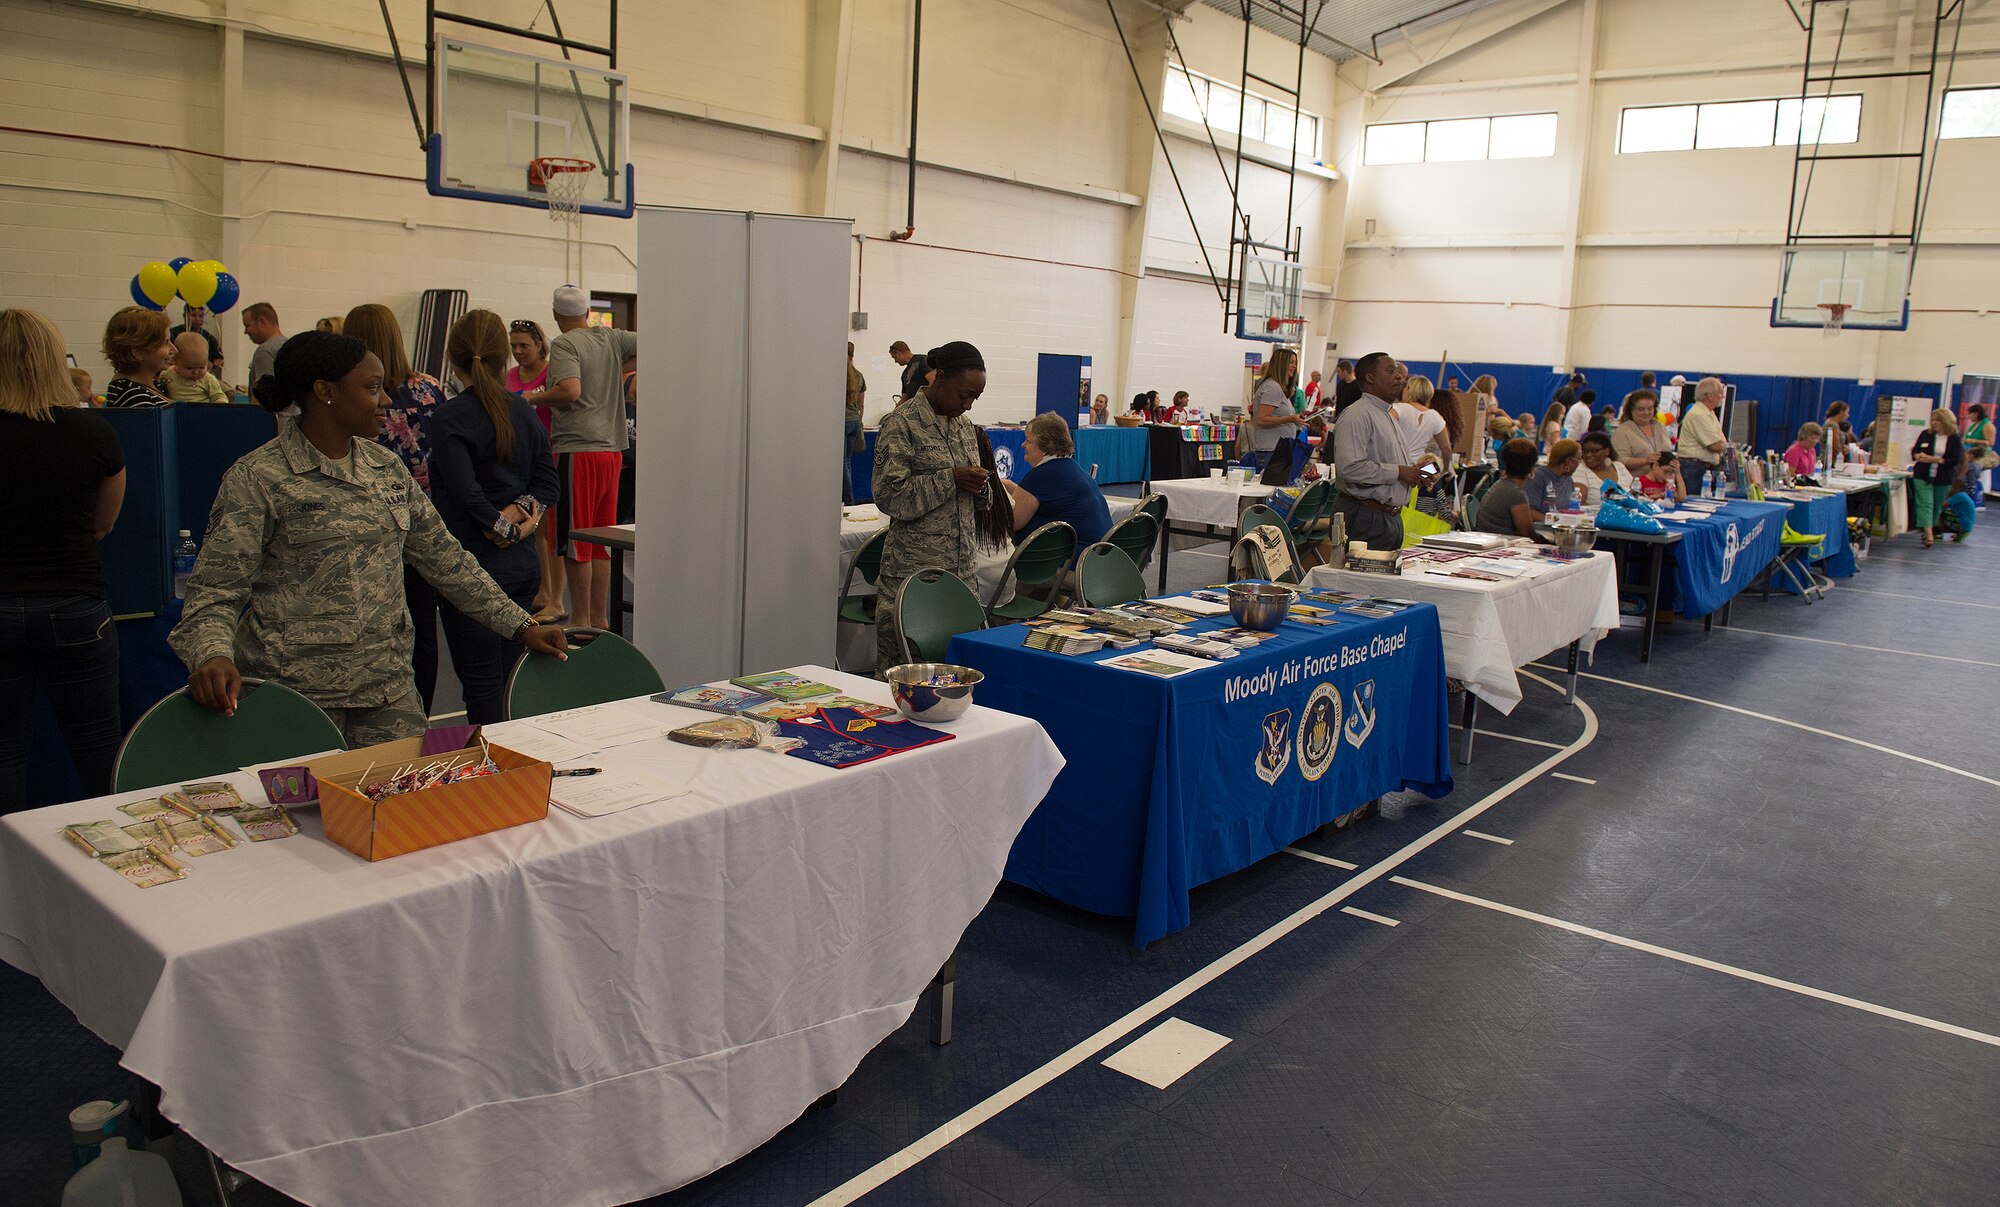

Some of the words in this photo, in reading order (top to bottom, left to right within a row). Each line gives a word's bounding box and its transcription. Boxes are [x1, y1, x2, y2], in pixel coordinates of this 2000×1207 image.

[300, 501, 326, 513] JONES
[1224, 665, 1278, 704] Moody
[1279, 658, 1301, 687] Air
[1303, 655, 1337, 679] Force
[1340, 644, 1368, 668] Base
[1370, 624, 1408, 659] Chapel
[1310, 686, 1328, 705] STATES
[1328, 688, 1337, 701] AIR
[1319, 744, 1335, 772] CORPS
